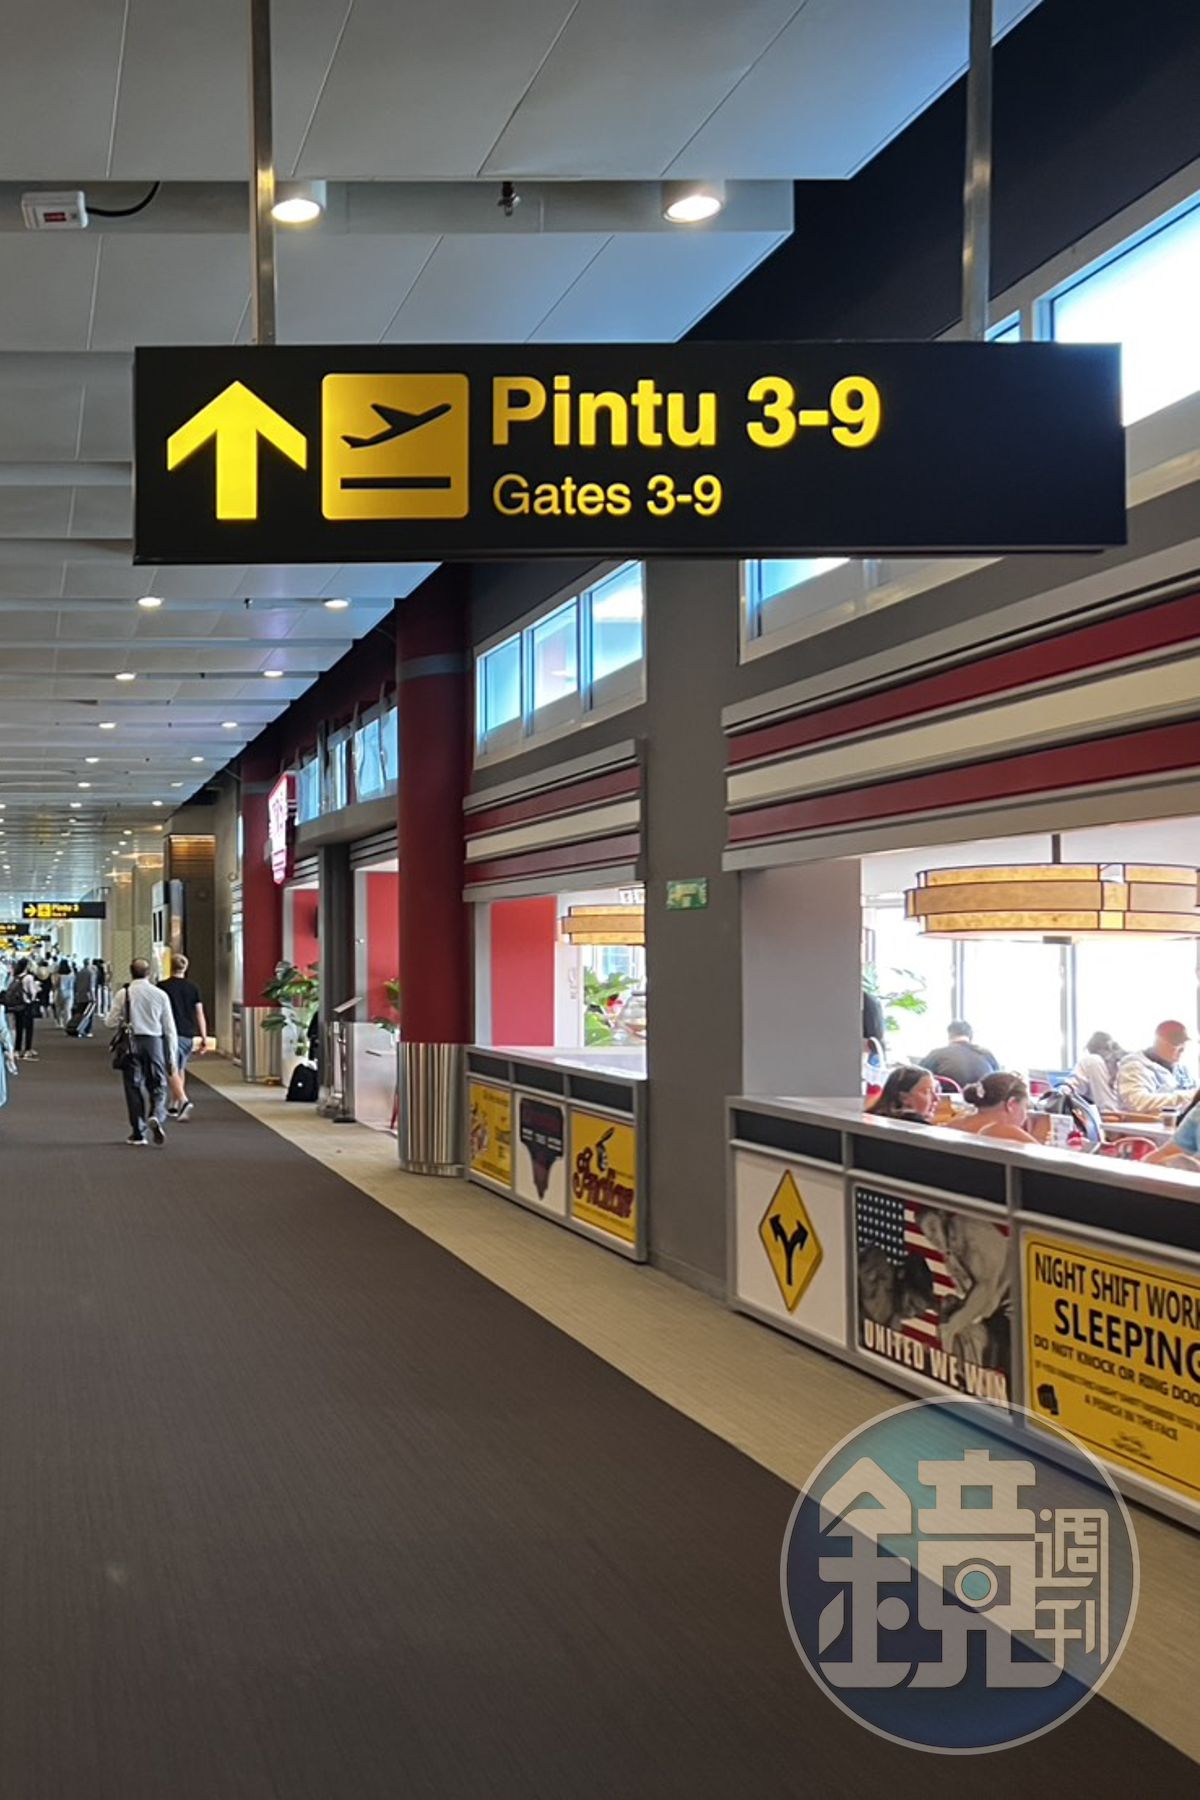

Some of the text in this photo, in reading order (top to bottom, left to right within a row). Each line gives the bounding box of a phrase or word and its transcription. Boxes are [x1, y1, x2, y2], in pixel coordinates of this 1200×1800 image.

[492, 375, 881, 447] Pintu 3-9
[492, 474, 722, 516] Gates 3-9
[1035, 1252, 1086, 1295] NIGHT
[1091, 1269, 1141, 1312] SHIFT
[864, 1318, 925, 1370] UNITED
[930, 1347, 960, 1387] WE
[1034, 1334, 1049, 1350] DO
[1051, 1341, 1074, 1360] NOT
[1077, 1350, 1116, 1376] KNOCK
[1118, 1365, 1135, 1383] OR
[1139, 1372, 1168, 1396] RING
[1055, 1299, 1200, 1384] SLEEPING
